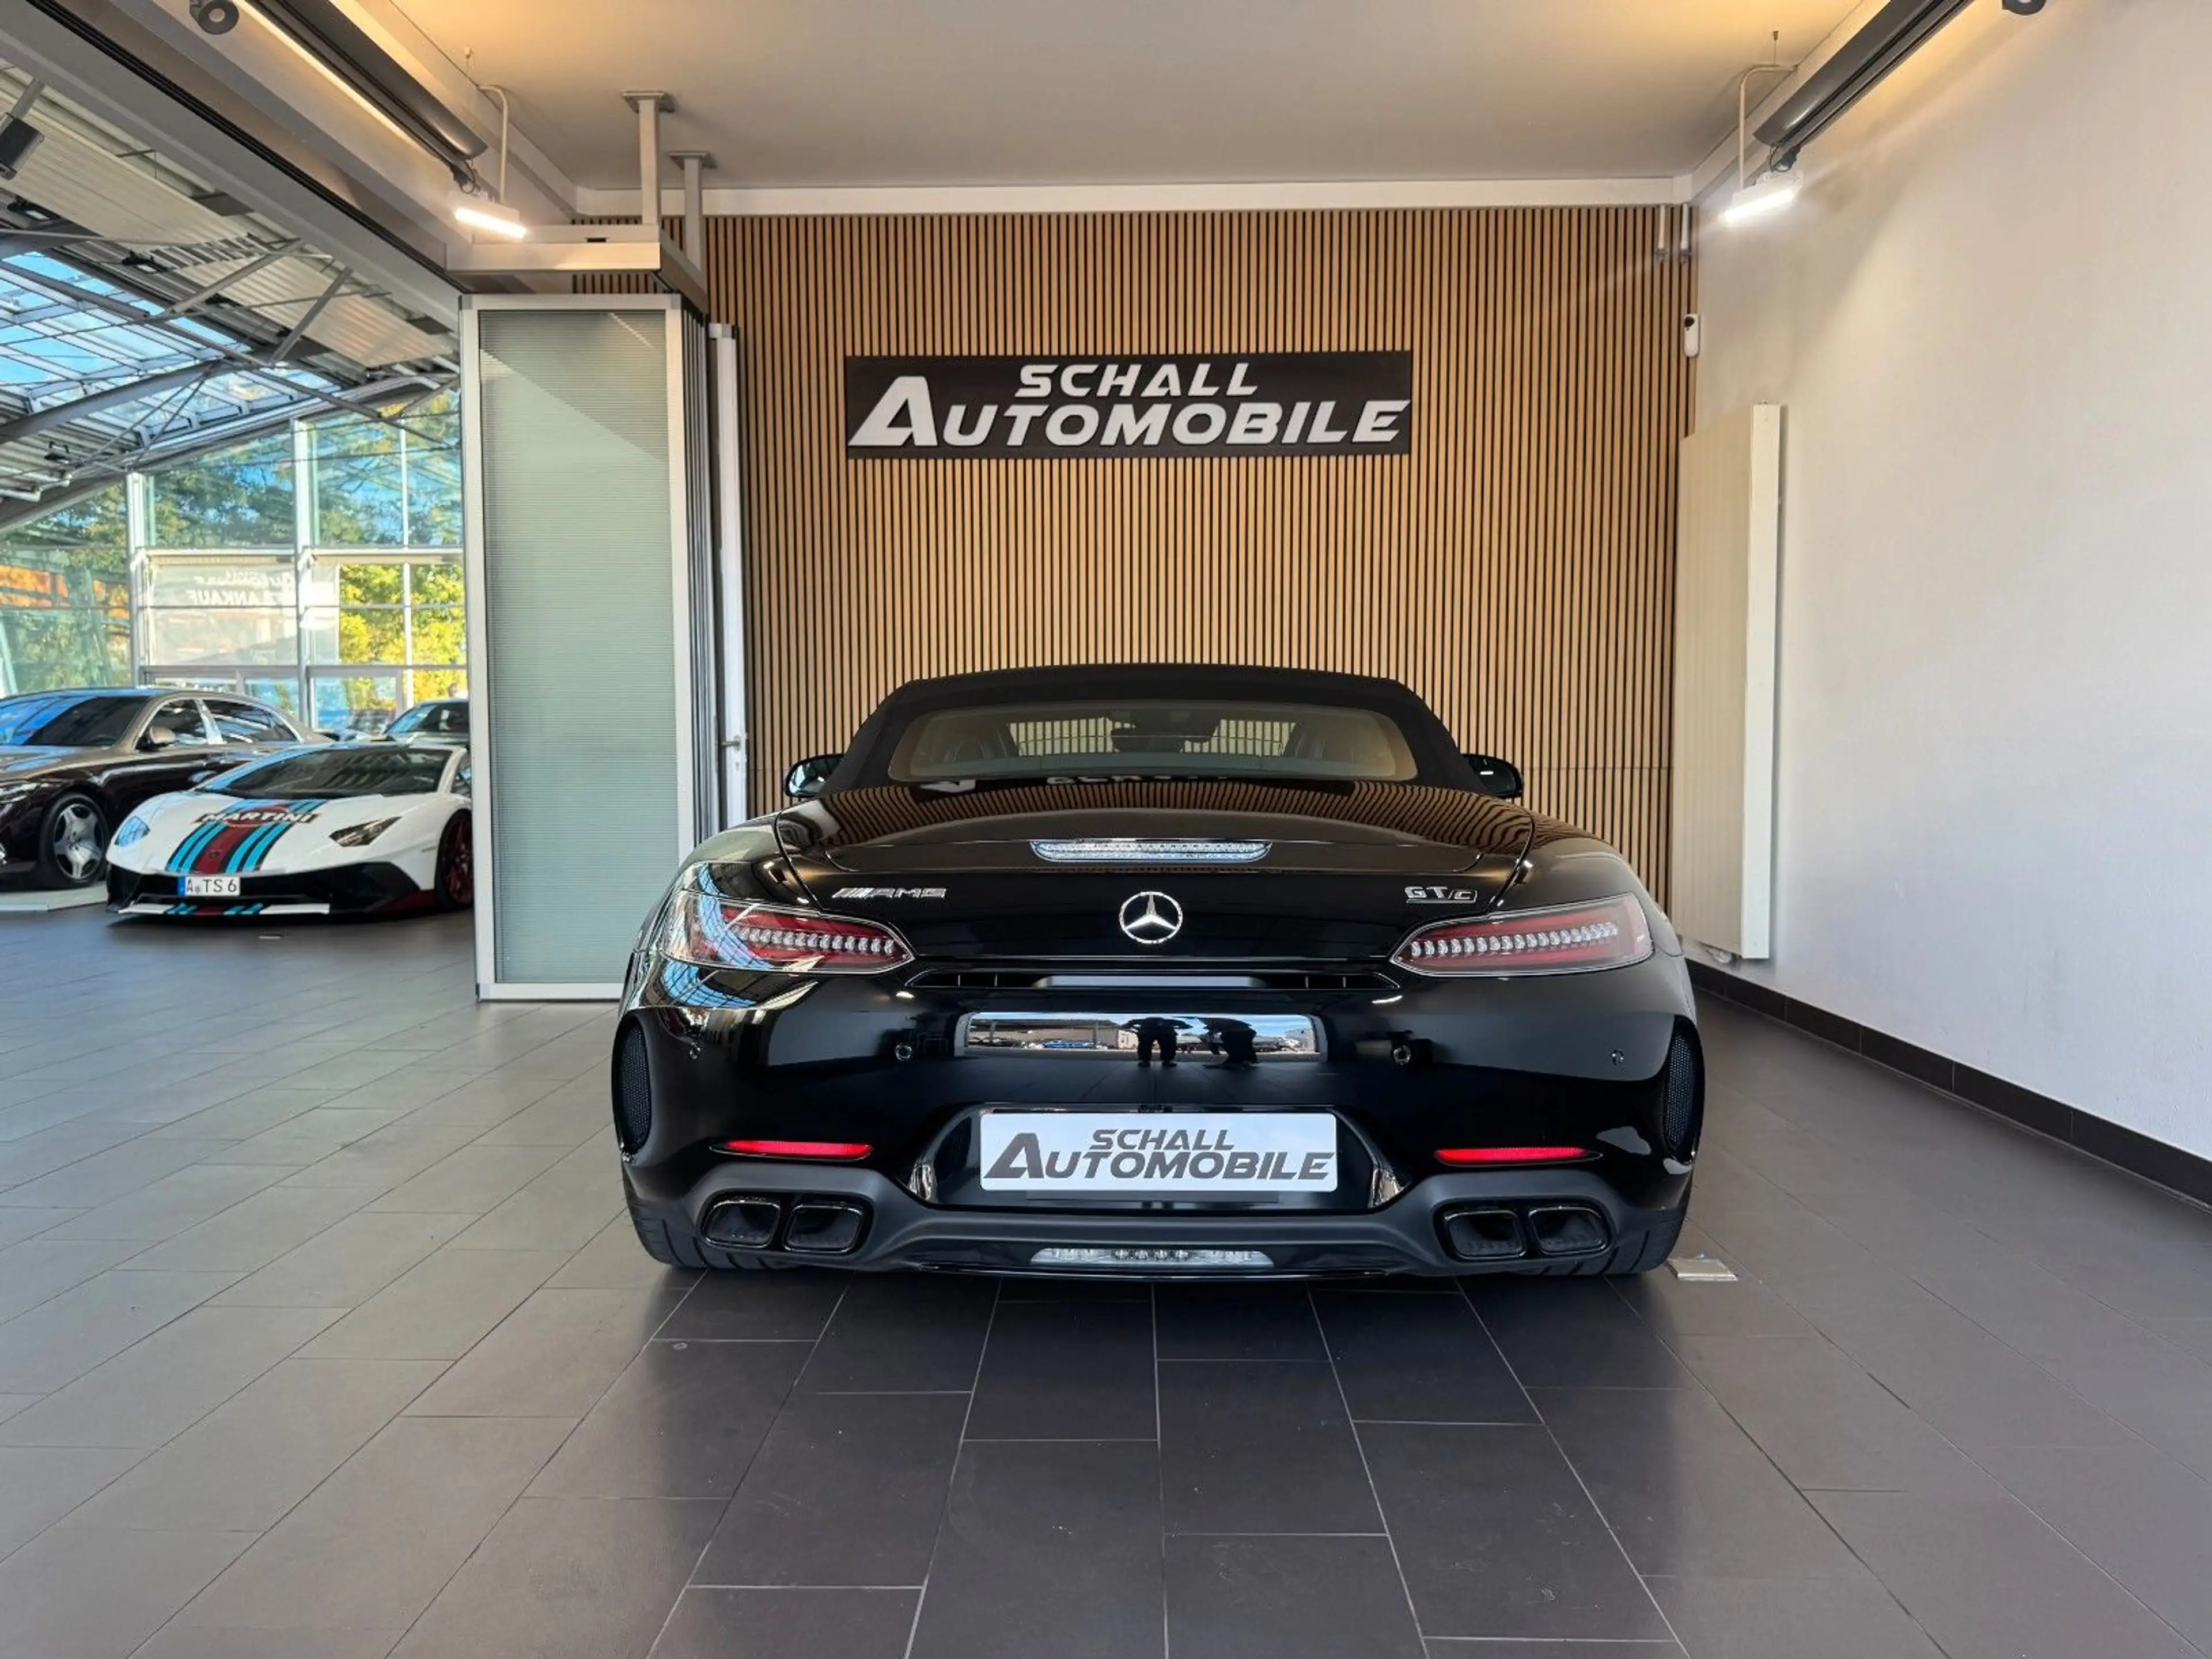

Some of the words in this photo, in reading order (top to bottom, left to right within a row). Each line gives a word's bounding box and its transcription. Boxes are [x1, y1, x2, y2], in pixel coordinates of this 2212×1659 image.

[1015, 363, 1258, 397] SCHALL
[848, 376, 1411, 446] AUTOMOBILE
[202, 810, 319, 823] MARTINI
[983, 1133, 1335, 1180] AUTOMOBILE
[1089, 1129, 1234, 1150] SCHALL
